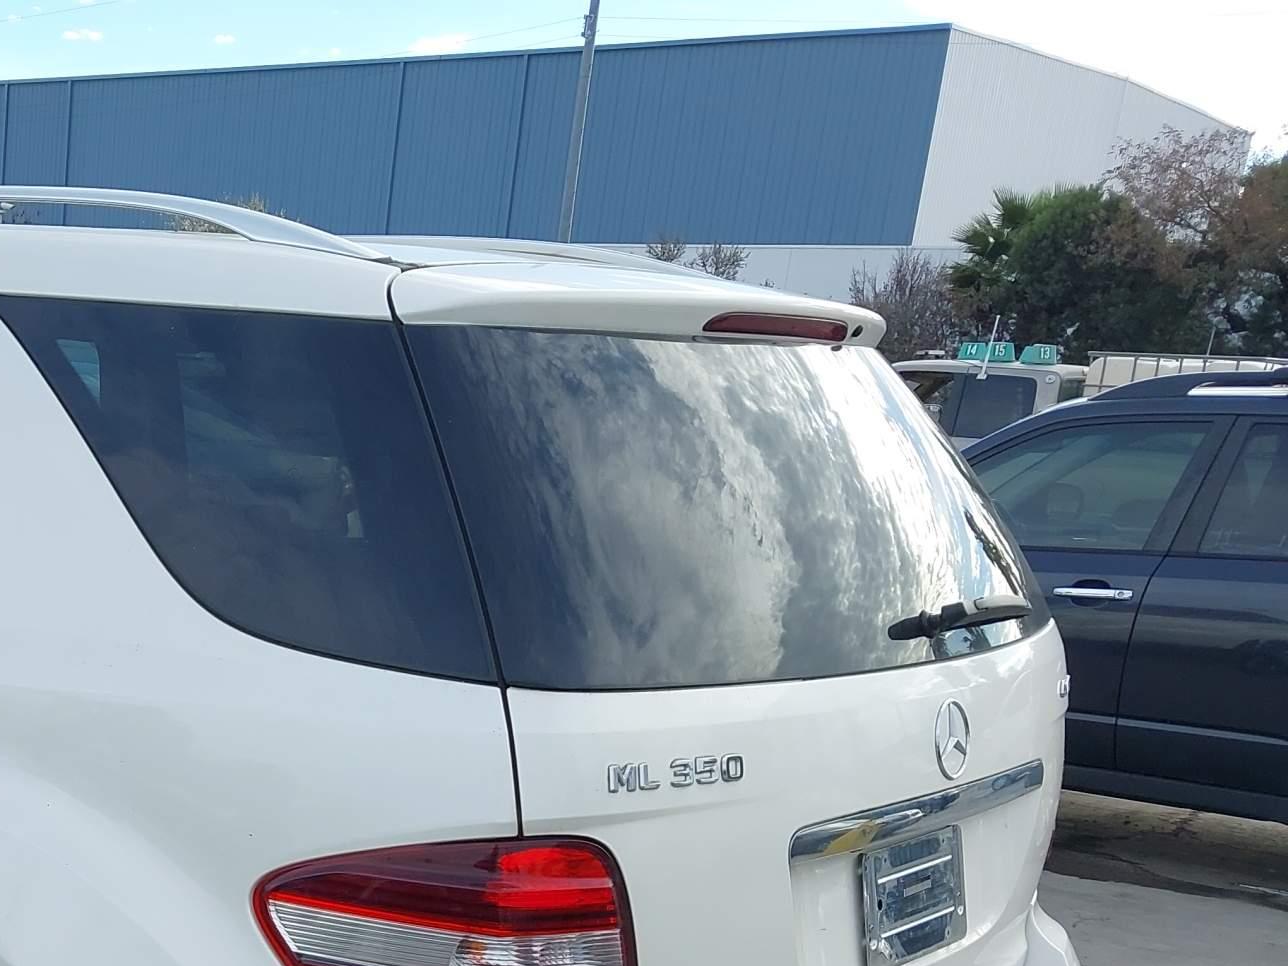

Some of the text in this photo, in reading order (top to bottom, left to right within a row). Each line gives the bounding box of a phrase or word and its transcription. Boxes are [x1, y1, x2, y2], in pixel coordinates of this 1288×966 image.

[967, 344, 978, 356] 14
[994, 343, 1007, 356] 15
[1040, 346, 1051, 359] 13
[607, 753, 744, 793] ML 350
